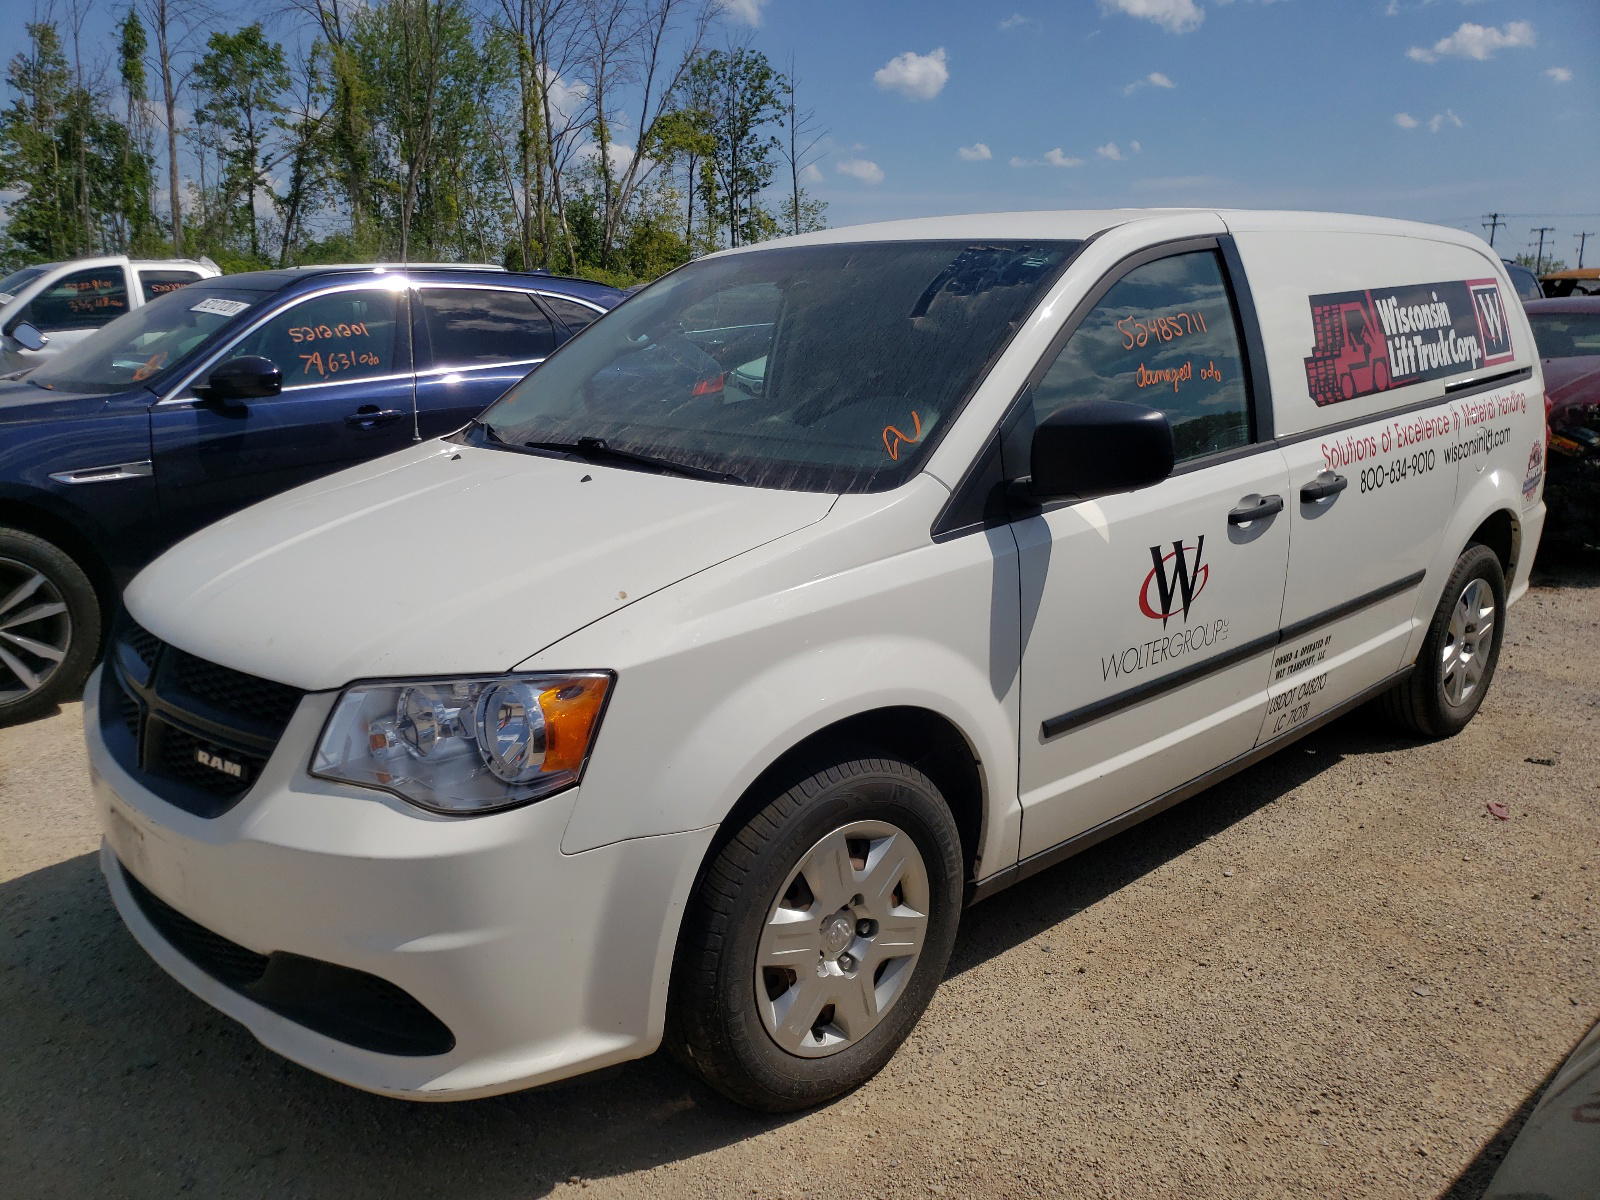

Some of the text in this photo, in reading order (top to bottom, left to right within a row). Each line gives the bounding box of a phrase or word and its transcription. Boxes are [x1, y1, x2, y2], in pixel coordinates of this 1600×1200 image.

[288, 322, 369, 342] 52121201
[1117, 311, 1208, 350] 52485711
[1375, 291, 1451, 336] Wisconsin
[1449, 329, 1482, 369] Corp.
[1321, 391, 1526, 470] Solutions of Excellence in Material Handling
[1360, 427, 1511, 494] 800-634-9010 wisconsinlift.com
[1101, 619, 1224, 682] WOLTERGROUP
[1274, 652, 1293, 668] OWNED
[1300, 638, 1324, 656] OPERATED
[1268, 687, 1298, 715] USDOT
[197, 750, 242, 777] RAM
